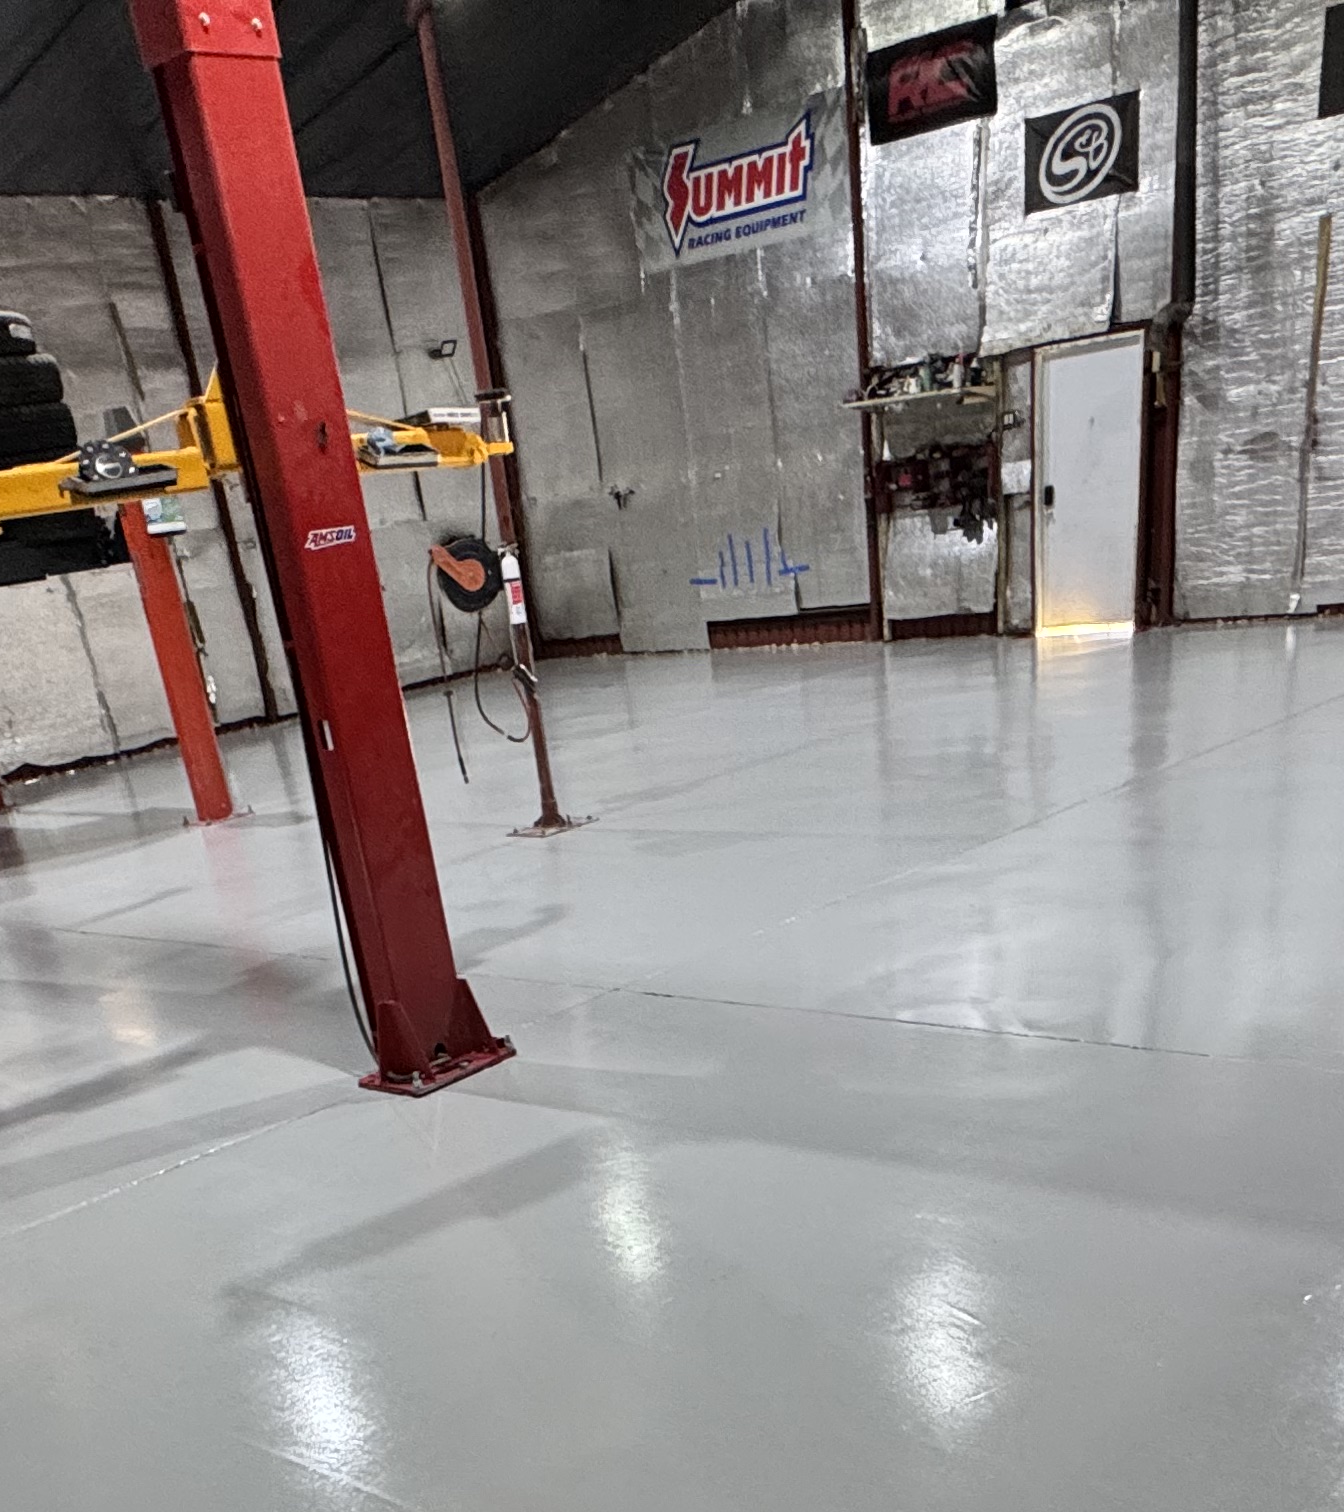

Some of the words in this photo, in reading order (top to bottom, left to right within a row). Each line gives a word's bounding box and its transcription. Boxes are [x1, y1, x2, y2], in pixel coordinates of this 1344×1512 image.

[687, 229, 732, 249] RACING
[734, 208, 807, 239] EQUIPMENT
[307, 527, 354, 548] AMSOIL
